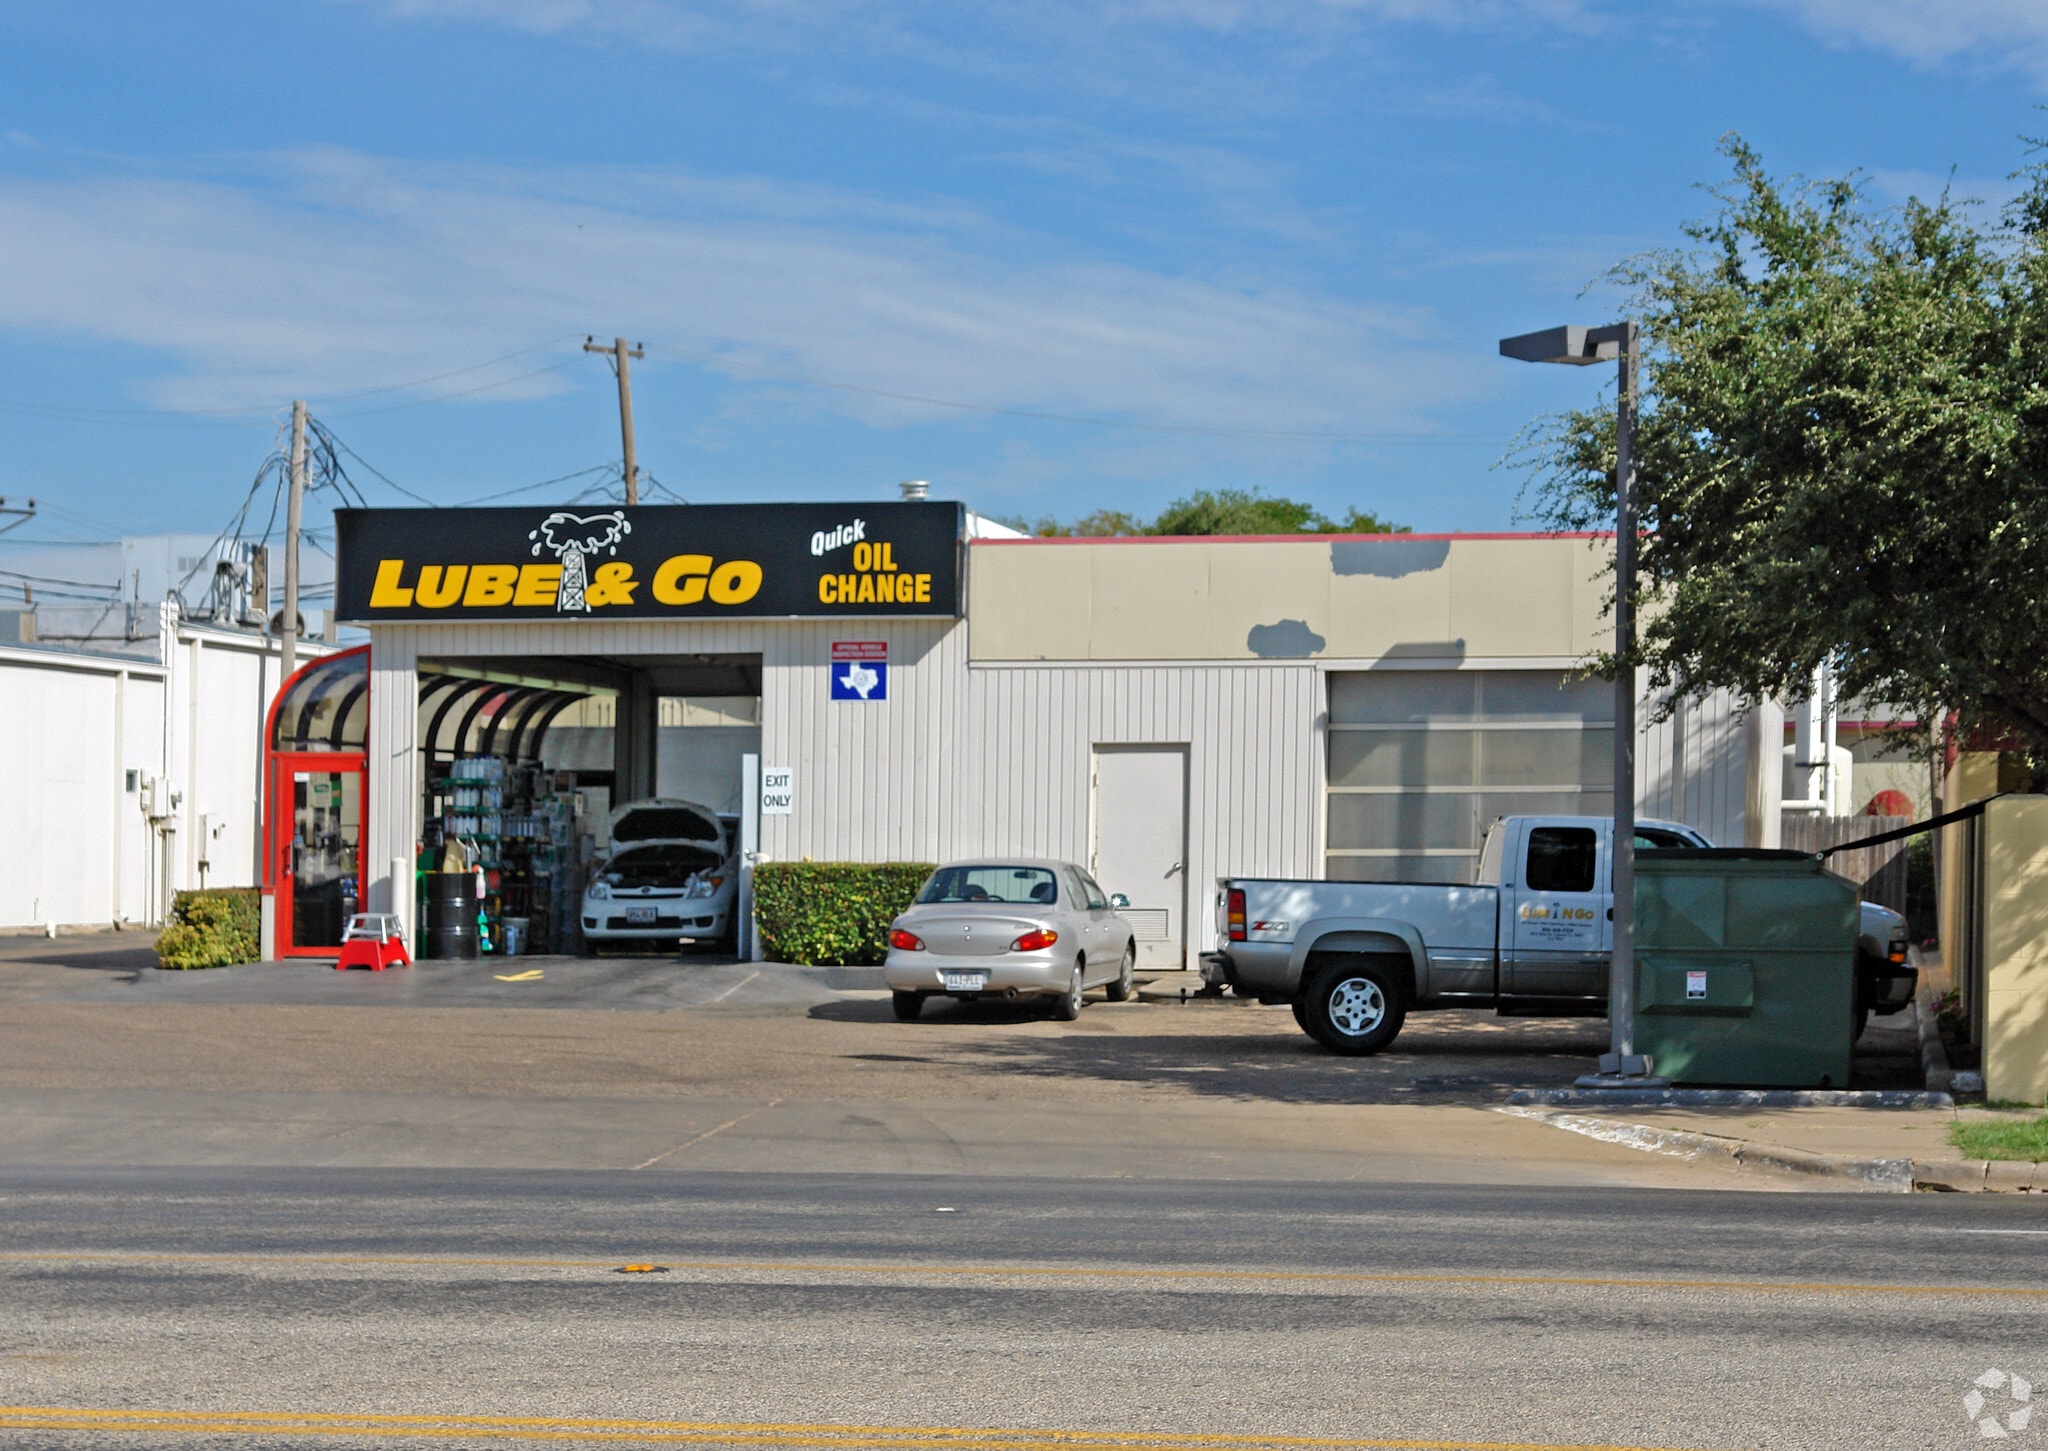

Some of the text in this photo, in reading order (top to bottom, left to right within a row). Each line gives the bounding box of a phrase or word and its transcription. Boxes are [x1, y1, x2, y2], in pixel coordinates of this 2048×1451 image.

[811, 518, 866, 556] Quick
[853, 541, 898, 572] OIL
[584, 561, 640, 607] &
[818, 573, 931, 604] CHANGE
[765, 774, 790, 787] EXIT
[763, 795, 791, 807] ONLY
